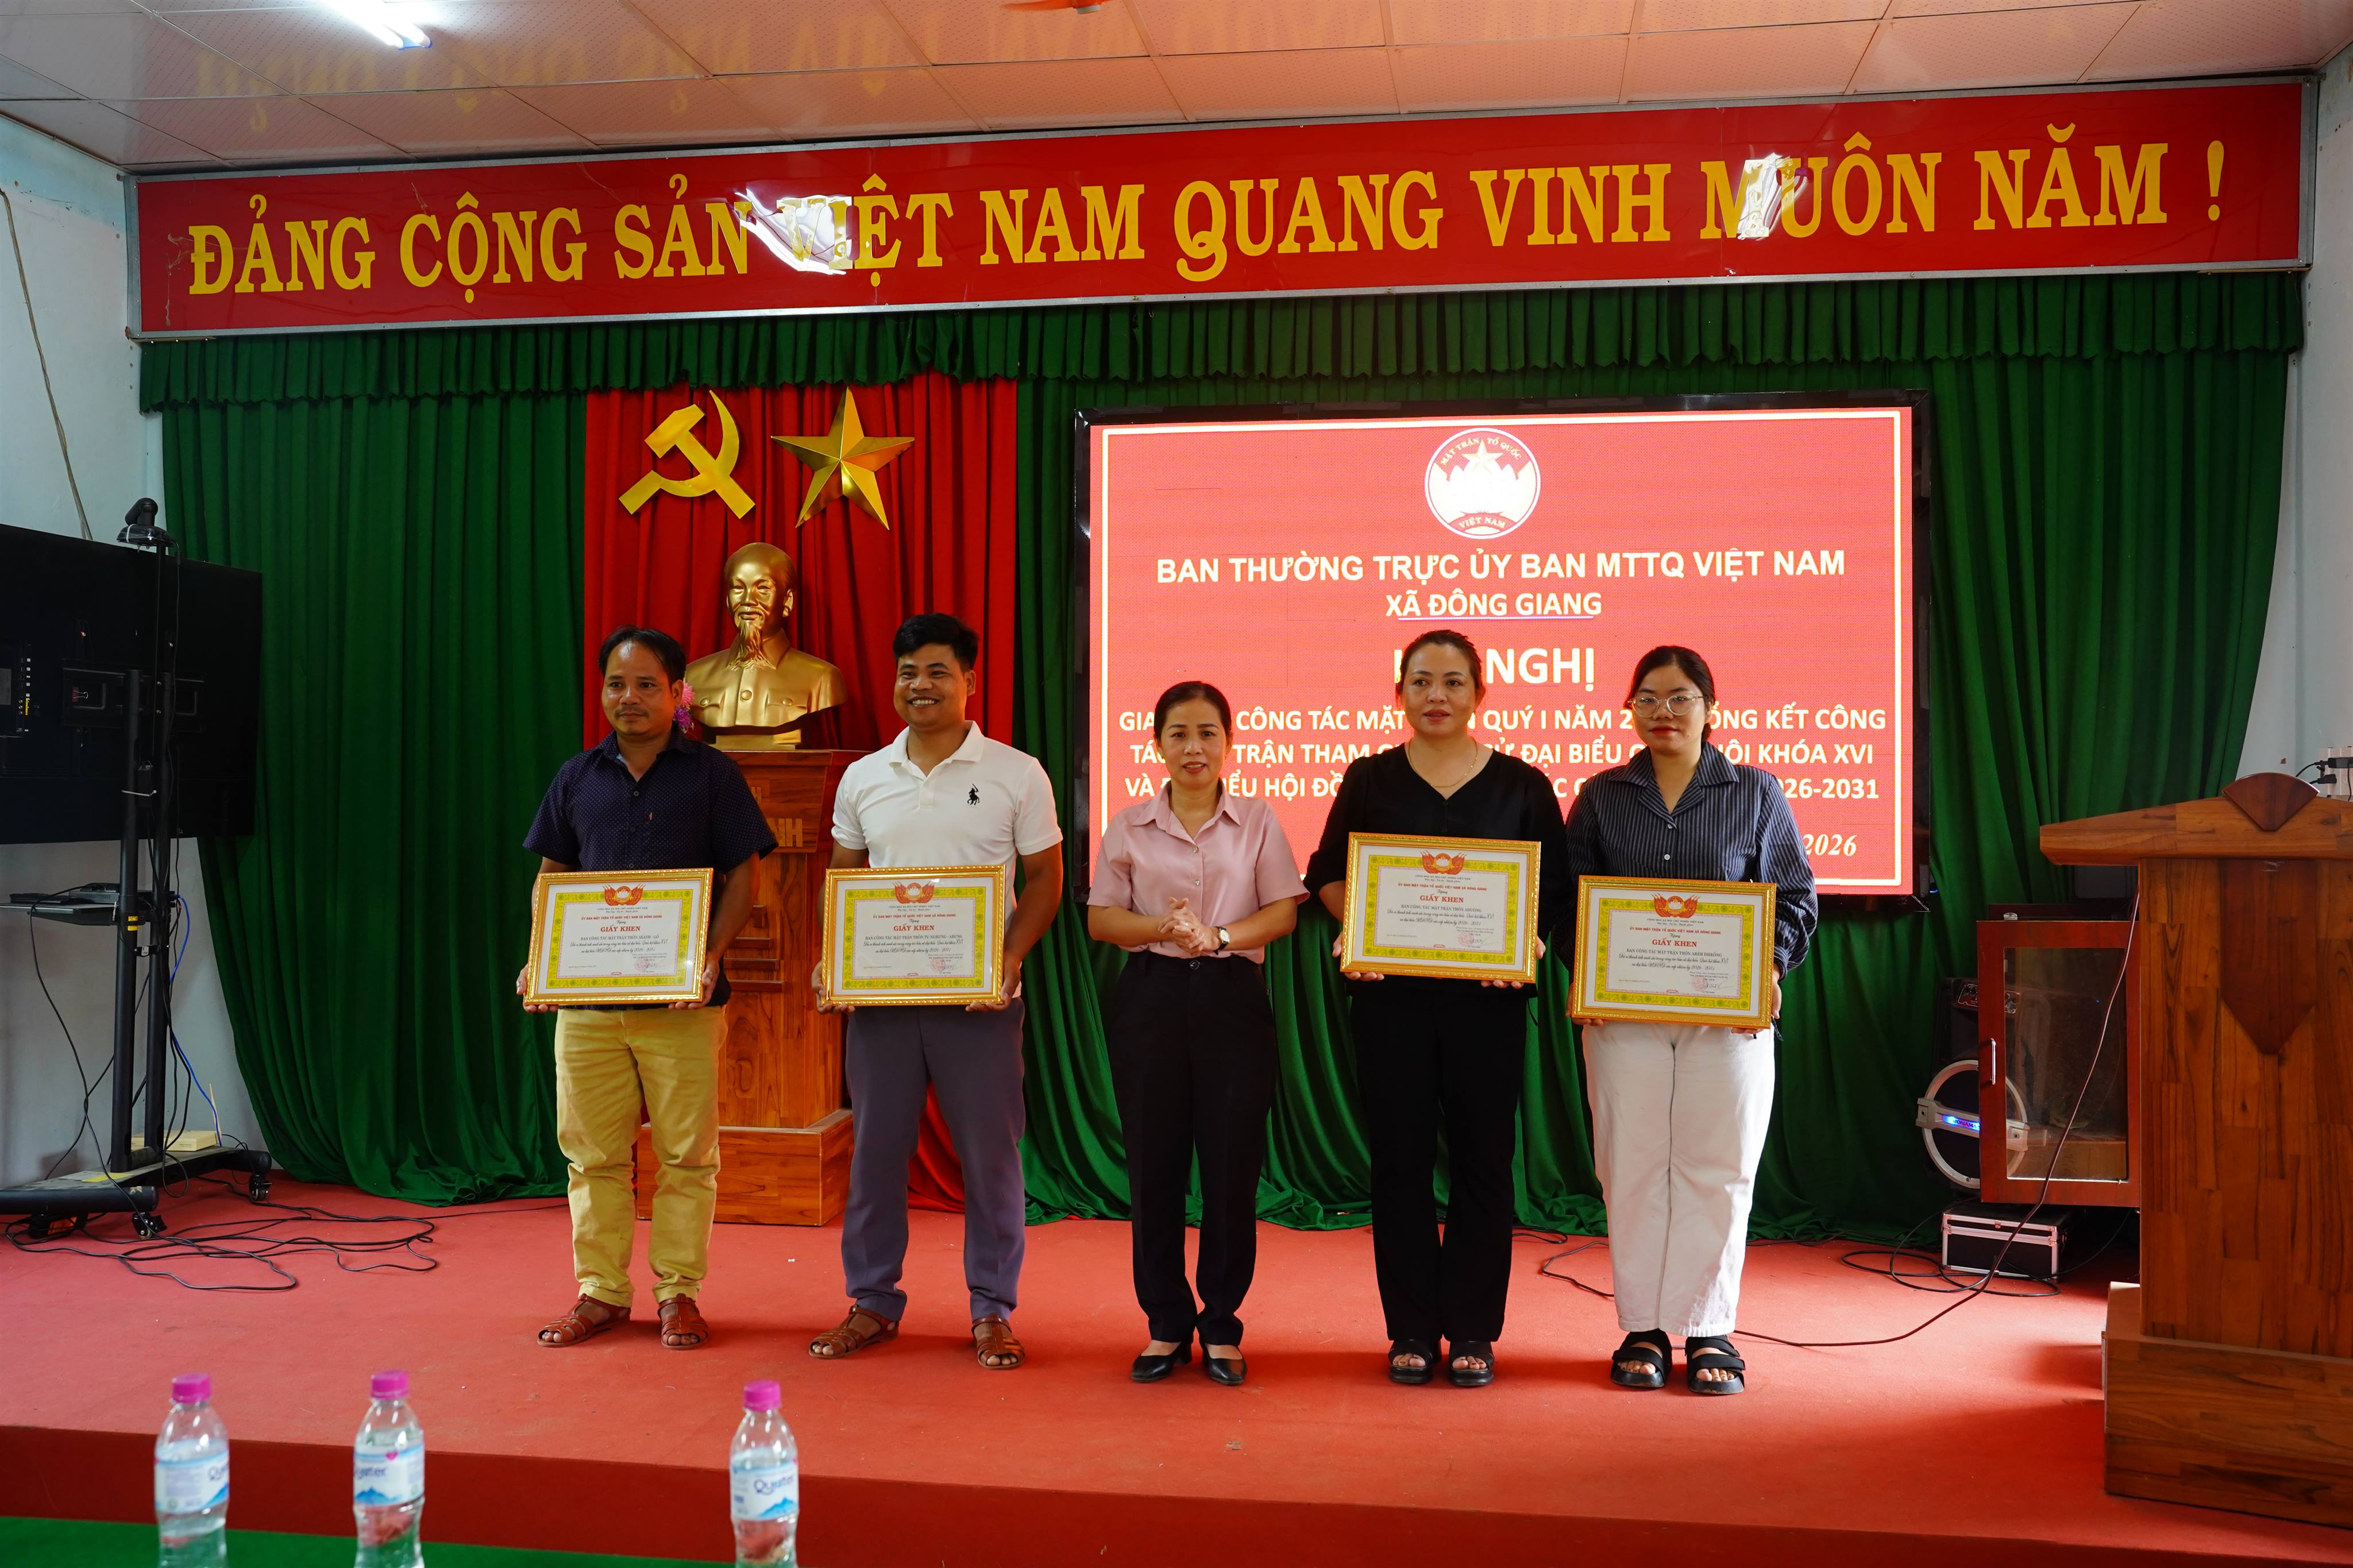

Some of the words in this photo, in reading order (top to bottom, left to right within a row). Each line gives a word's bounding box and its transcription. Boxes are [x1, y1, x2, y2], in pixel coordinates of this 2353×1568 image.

[189, 195, 375, 294] ĐẢNG
[400, 192, 587, 303] CỘNG
[615, 174, 753, 279] SẢN
[777, 173, 954, 287] VIỆT
[980, 184, 1144, 264] NAM
[1174, 171, 1443, 281] QUANG
[1470, 164, 1671, 246] VINH
[1700, 132, 1941, 239] MUÔN
[1974, 123, 2167, 230] NĂM
[1484, 517, 1506, 528] NAM
[1157, 558, 1218, 583] BAN
[1229, 550, 1363, 582] THƯỜNG
[1373, 554, 1460, 585] TRỰC
[1470, 548, 1513, 579] ỦY
[1521, 553, 1586, 578] BAN
[1597, 551, 1684, 578] MTTQ
[1692, 547, 1765, 582] VIỆT
[1774, 550, 1845, 576] NAM
[1386, 589, 1421, 616] XÃ
[1428, 588, 1507, 616] ĐÔNG
[1515, 592, 1602, 616] GIANG
[1486, 647, 1594, 692] NGHỊ
[1119, 711, 1155, 731] GIA
[1236, 705, 1302, 731] CÔNG
[1307, 705, 1350, 730] TÁC
[1356, 705, 1406, 735] MẶT
[1483, 705, 1534, 733] QUÝ
[1541, 710, 1546, 729] I
[1554, 704, 1612, 729] NĂM
[1766, 701, 1809, 729] KẾT
[1815, 704, 1886, 729] CÔNG
[1232, 739, 1294, 768] TRẬN
[1300, 744, 1370, 763] THAM
[1520, 744, 1561, 768] ĐẠI
[1569, 734, 1622, 764] BIỂU
[1758, 739, 1827, 764] KHÓA
[1833, 744, 1873, 764] XVI
[1124, 773, 1155, 797] VÀ
[1264, 773, 1305, 801] HỘI
[1803, 833, 1857, 856] 2026
[1420, 893, 1439, 901] GIẤY
[893, 923, 911, 931] GIẤY
[1652, 937, 1671, 946] GIẤY
